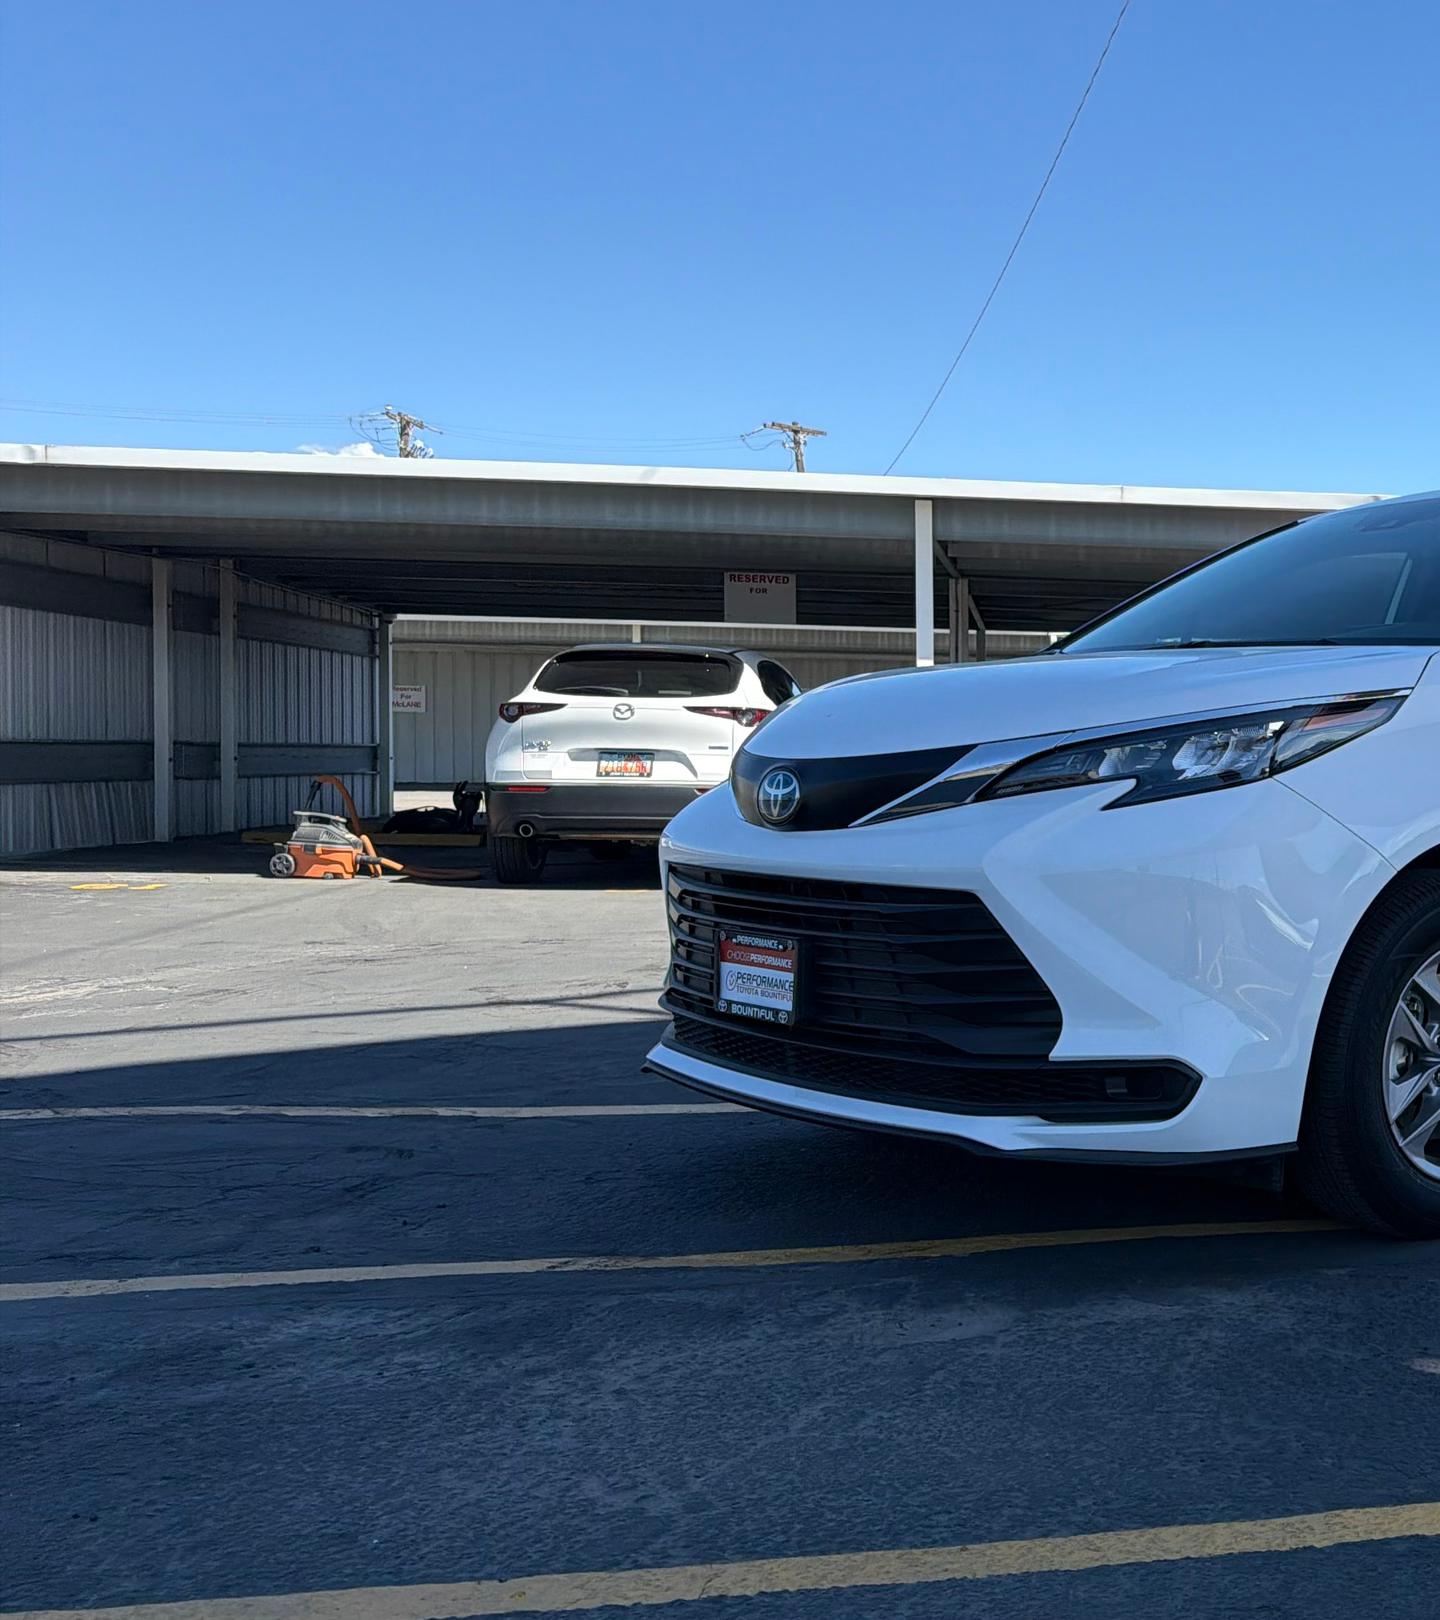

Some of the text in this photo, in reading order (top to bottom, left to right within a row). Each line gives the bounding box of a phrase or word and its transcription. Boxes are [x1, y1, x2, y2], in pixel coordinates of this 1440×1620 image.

[729, 574, 790, 584] RESERVED
[736, 935, 779, 949] PERFORMANCE
[736, 971, 794, 992] PERFORMANCE
[736, 985, 759, 996] TOYOTA
[731, 1003, 775, 1021] BOUNTIFUL
